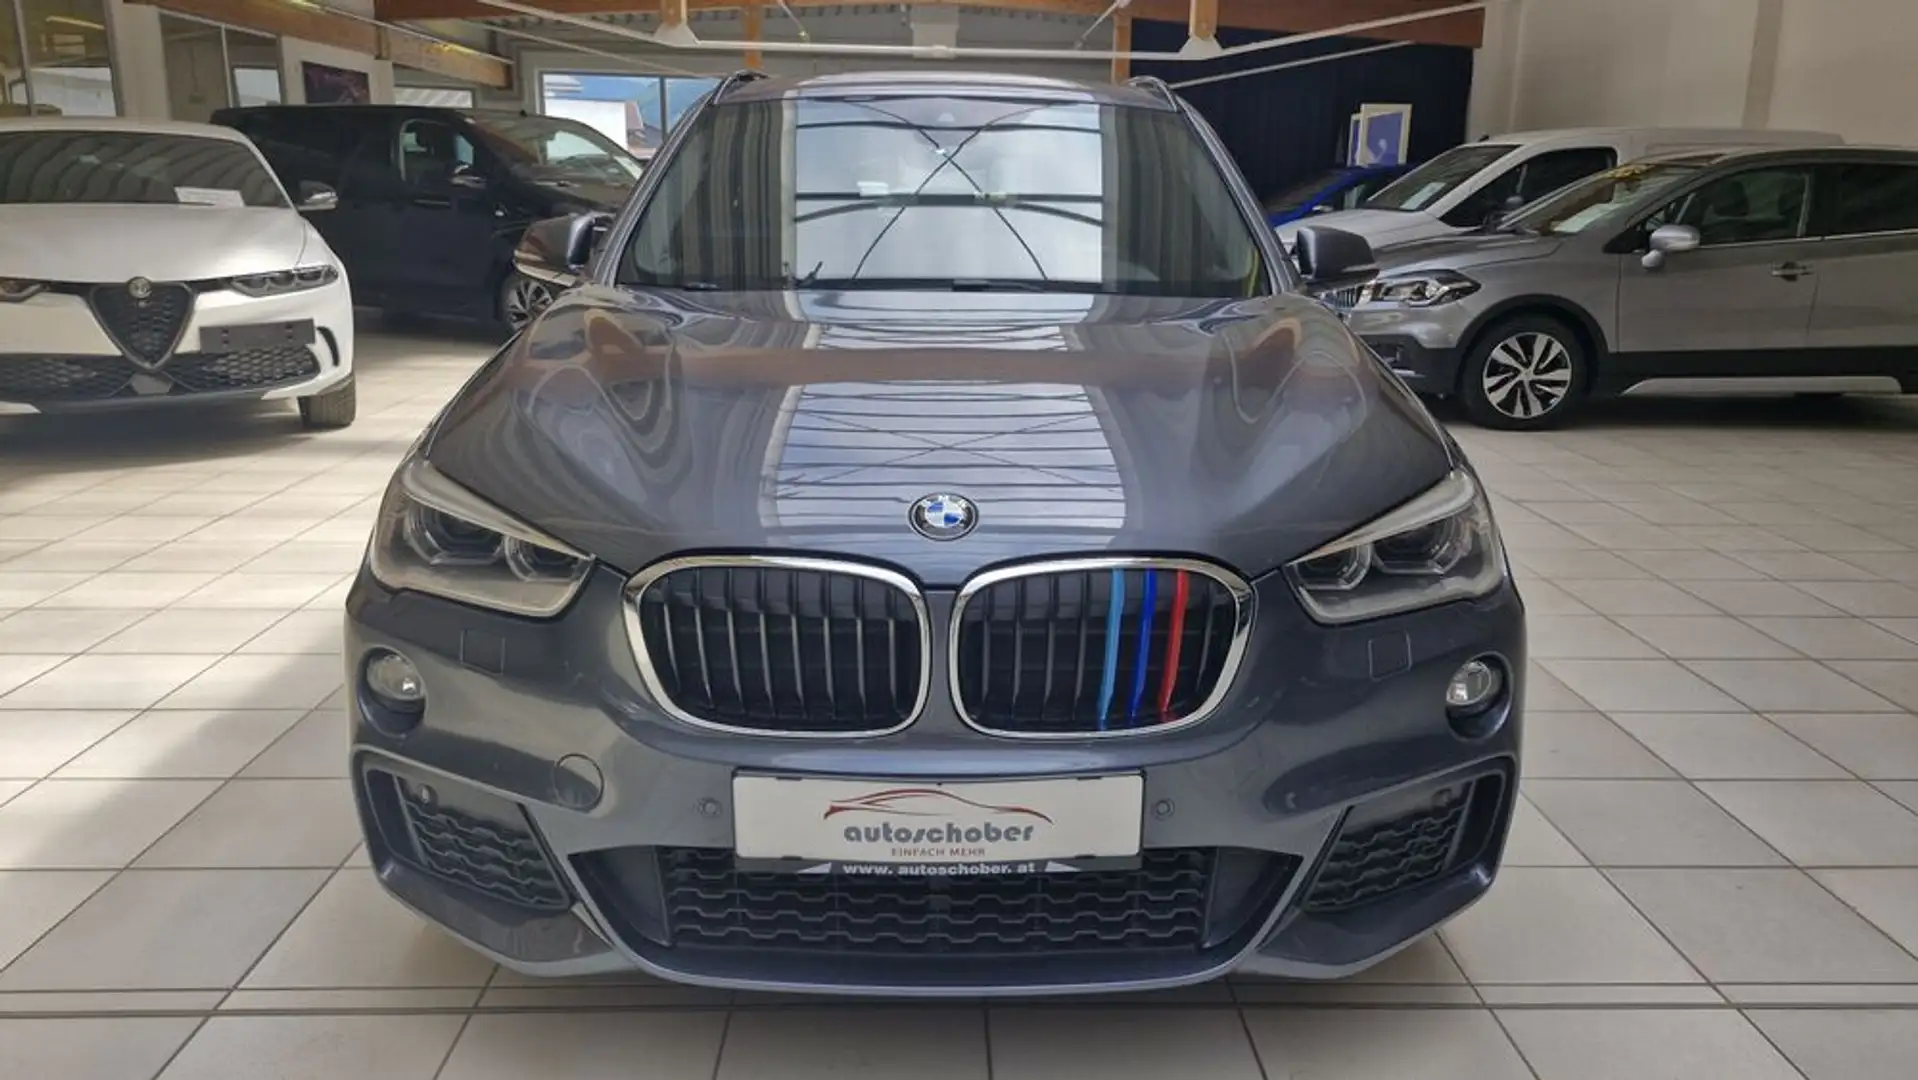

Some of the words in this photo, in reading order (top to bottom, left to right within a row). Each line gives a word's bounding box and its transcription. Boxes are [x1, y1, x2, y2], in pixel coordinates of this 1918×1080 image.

[843, 821, 1035, 844] autoschober
[891, 847, 945, 858] EINFACH
[949, 847, 986, 858] MEHR
